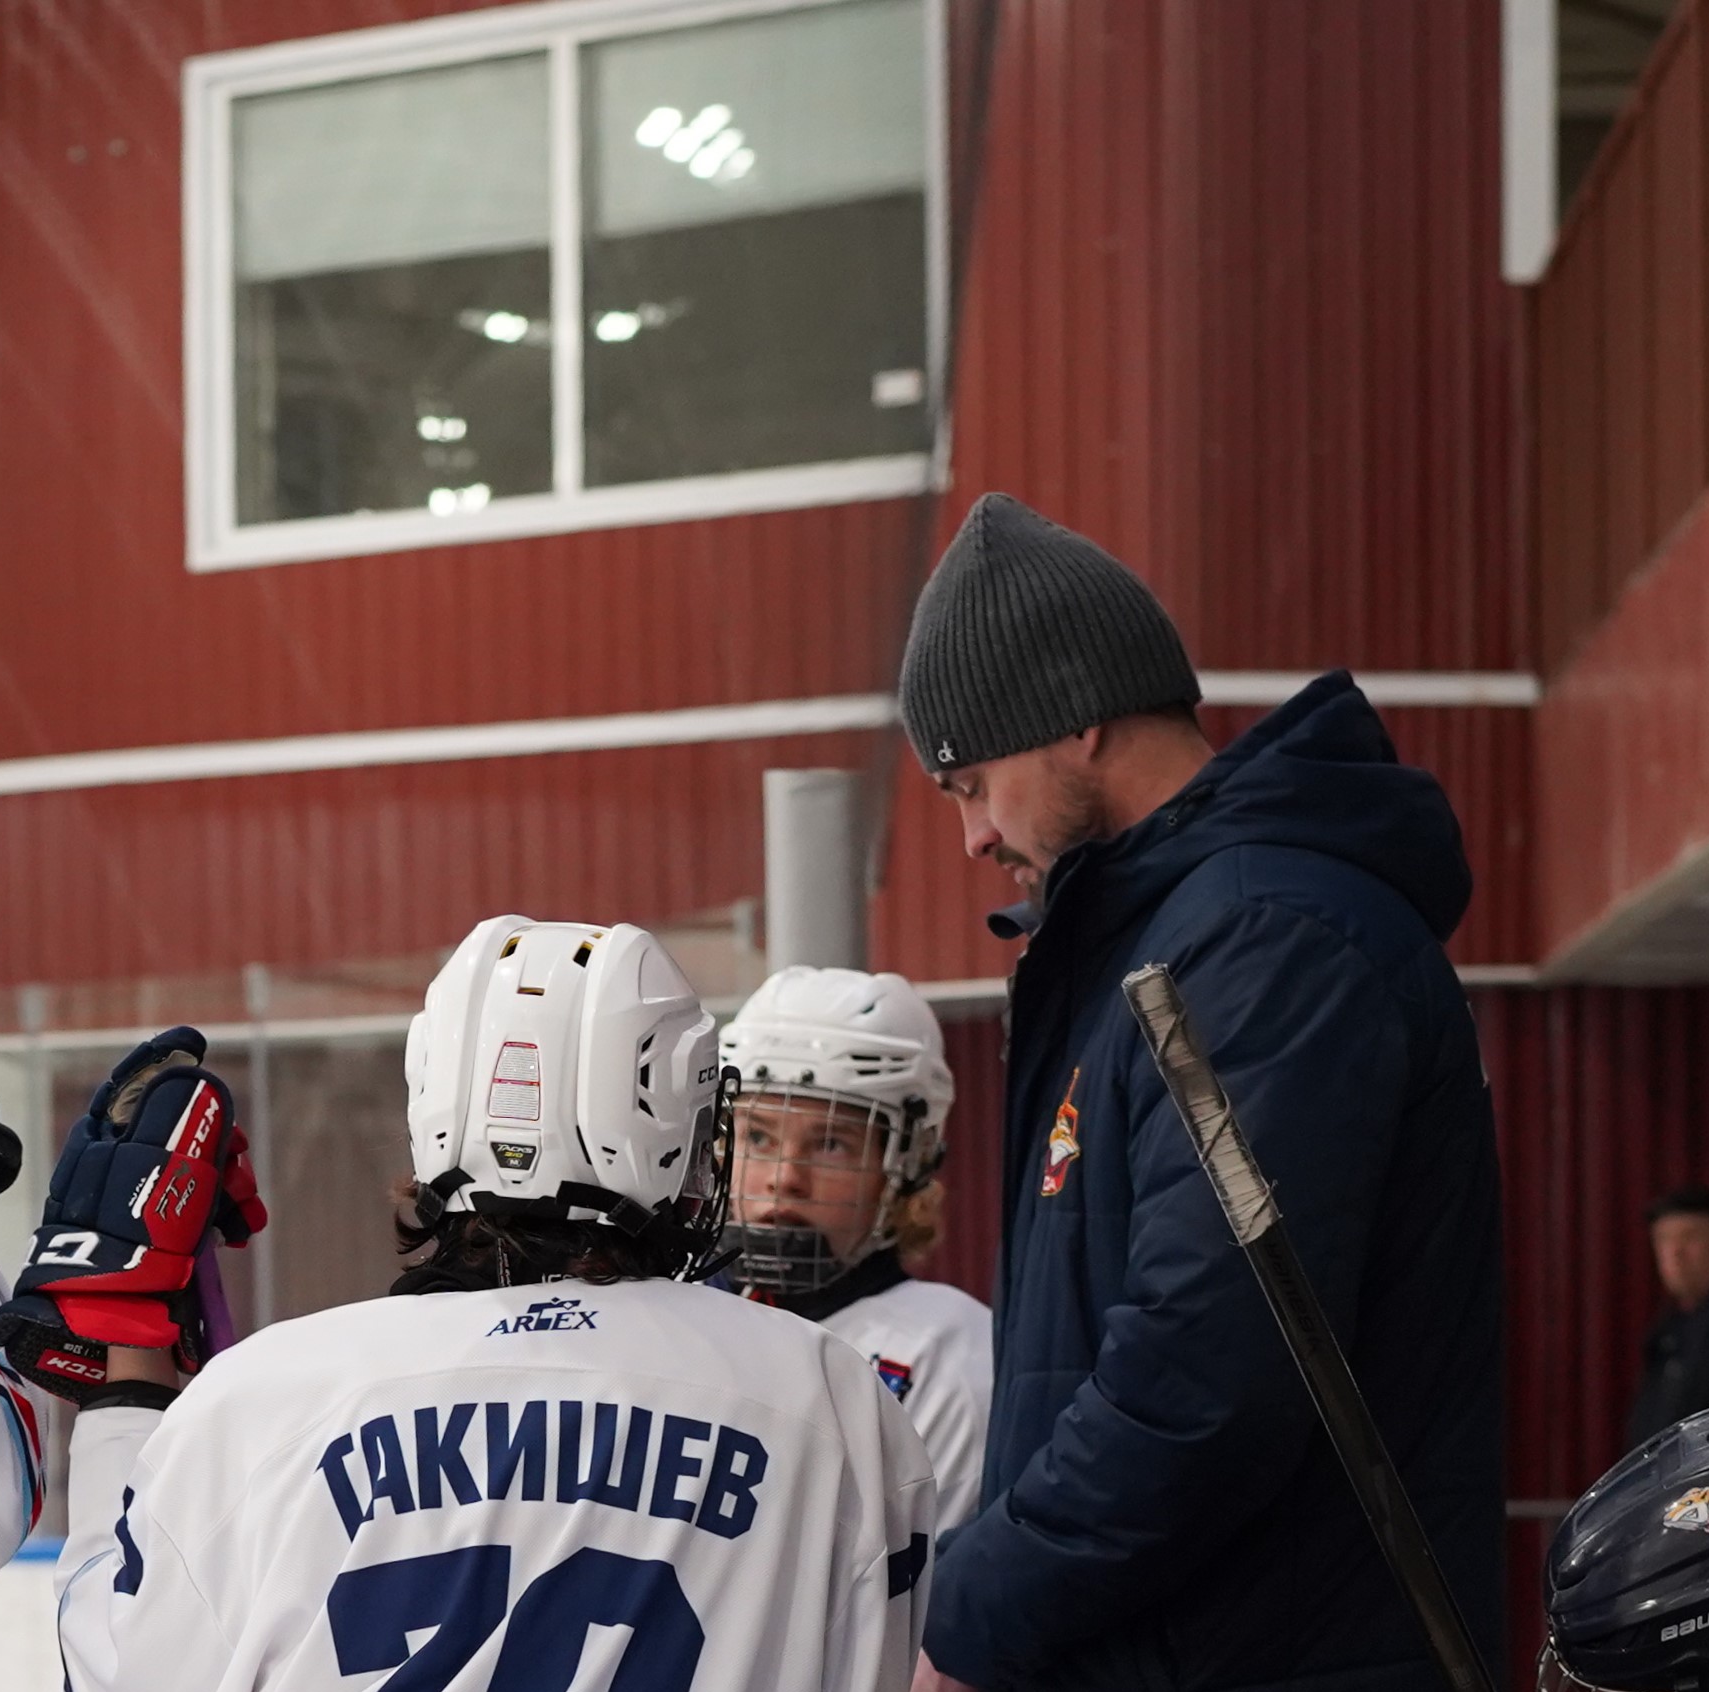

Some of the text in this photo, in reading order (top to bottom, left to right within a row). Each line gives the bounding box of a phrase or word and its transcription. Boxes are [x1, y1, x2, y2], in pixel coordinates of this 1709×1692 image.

[187, 1095, 221, 1160] CCM
[496, 1143, 535, 1154] TACKS
[47, 1355, 108, 1382] CCM
